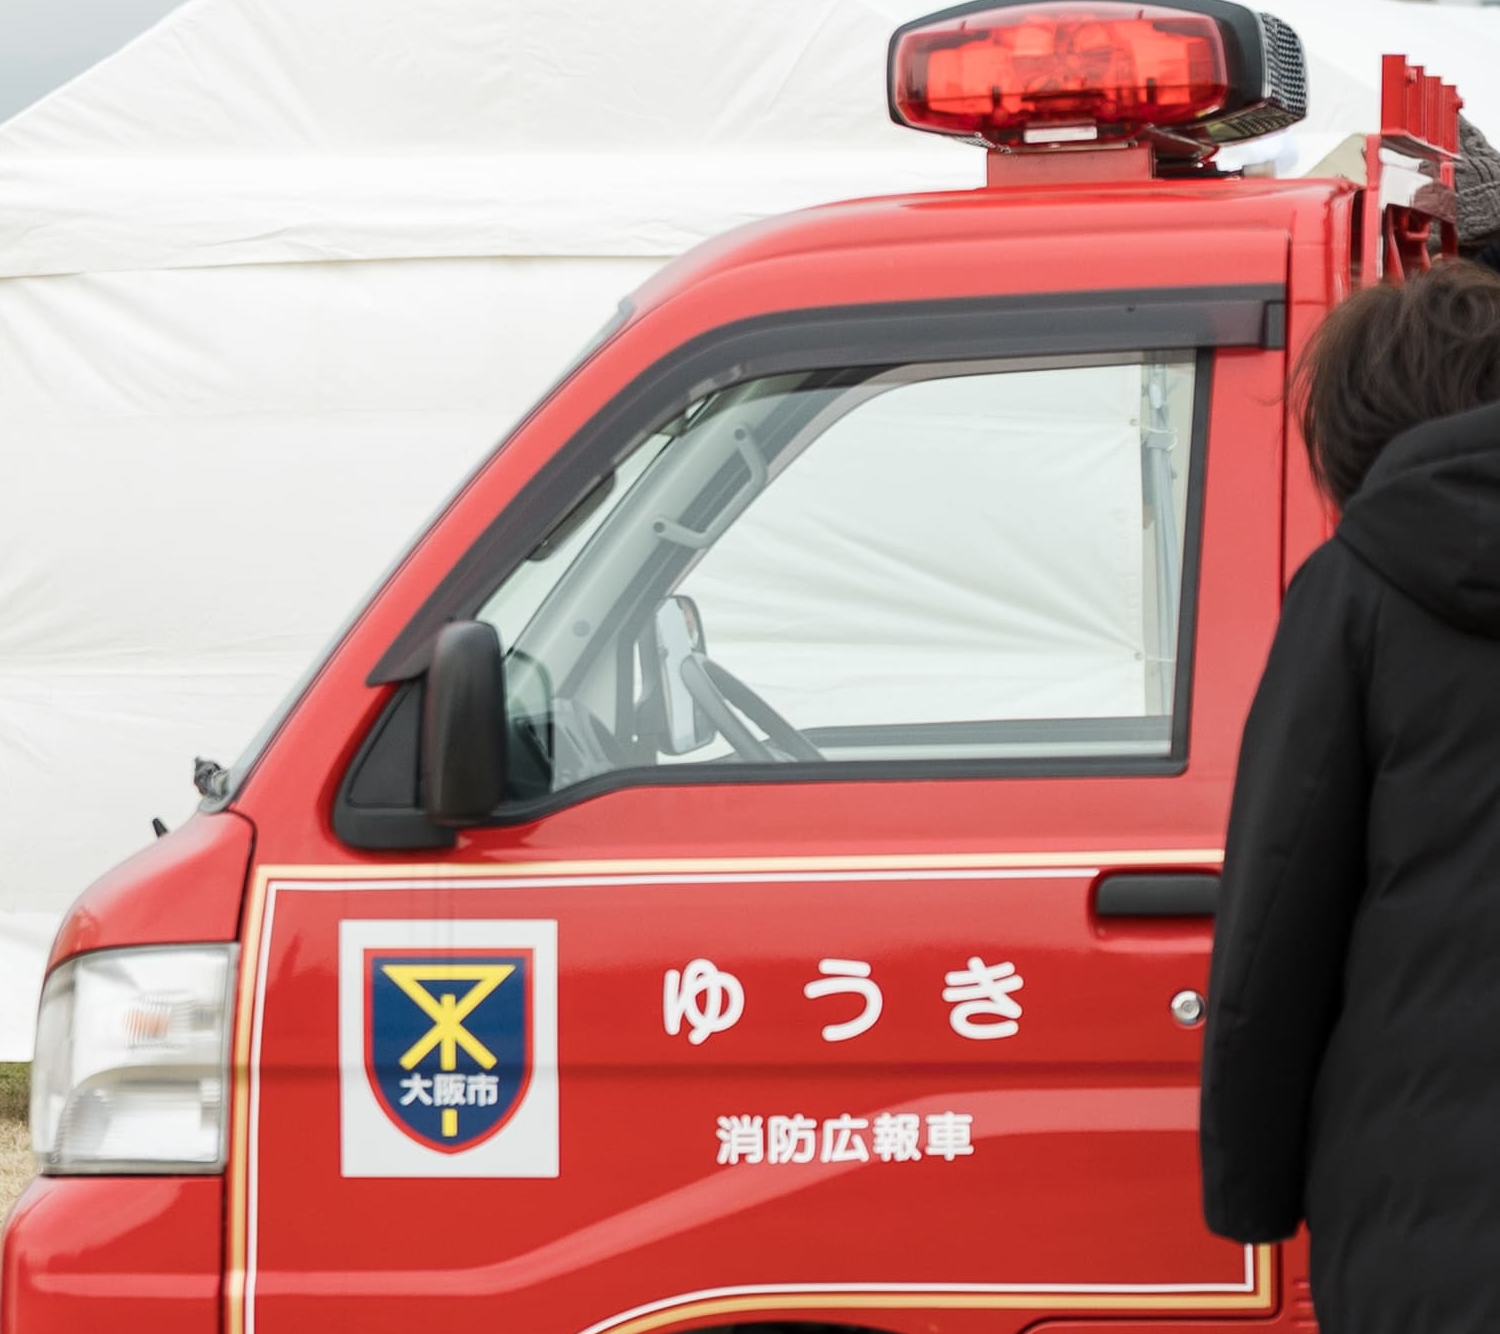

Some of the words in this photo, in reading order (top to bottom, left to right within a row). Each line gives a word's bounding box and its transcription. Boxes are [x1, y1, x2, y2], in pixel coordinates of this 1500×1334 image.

[663, 956, 1025, 1045] ゆうき
[400, 1072, 499, 1107] 大阪市
[716, 1112, 975, 1165] 消防広報車
